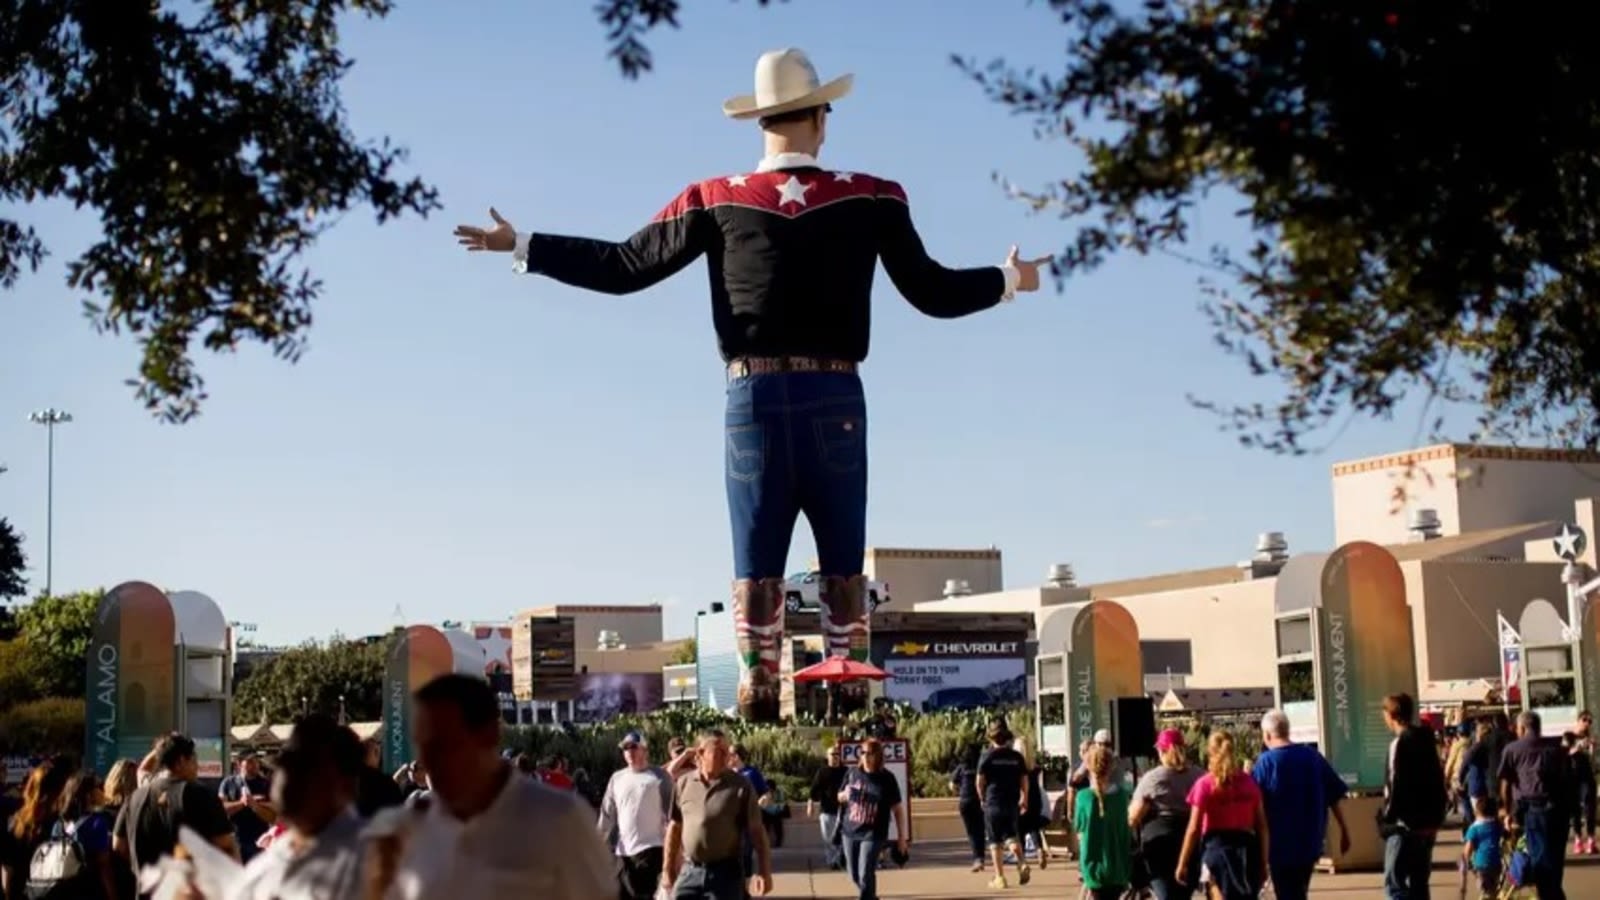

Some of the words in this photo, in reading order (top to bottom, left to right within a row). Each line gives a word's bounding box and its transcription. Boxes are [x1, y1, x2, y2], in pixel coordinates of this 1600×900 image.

[934, 641, 1018, 654] CHEVROLET
[1329, 611, 1349, 709] MONUMENT
[916, 665, 927, 674] ON
[928, 665, 938, 674] TO
[940, 665, 960, 674] YOUR
[1078, 665, 1091, 706] HALL
[97, 643, 118, 744] ALAMO
[392, 680, 403, 755] MONUMENT
[843, 744, 904, 759] POCE
